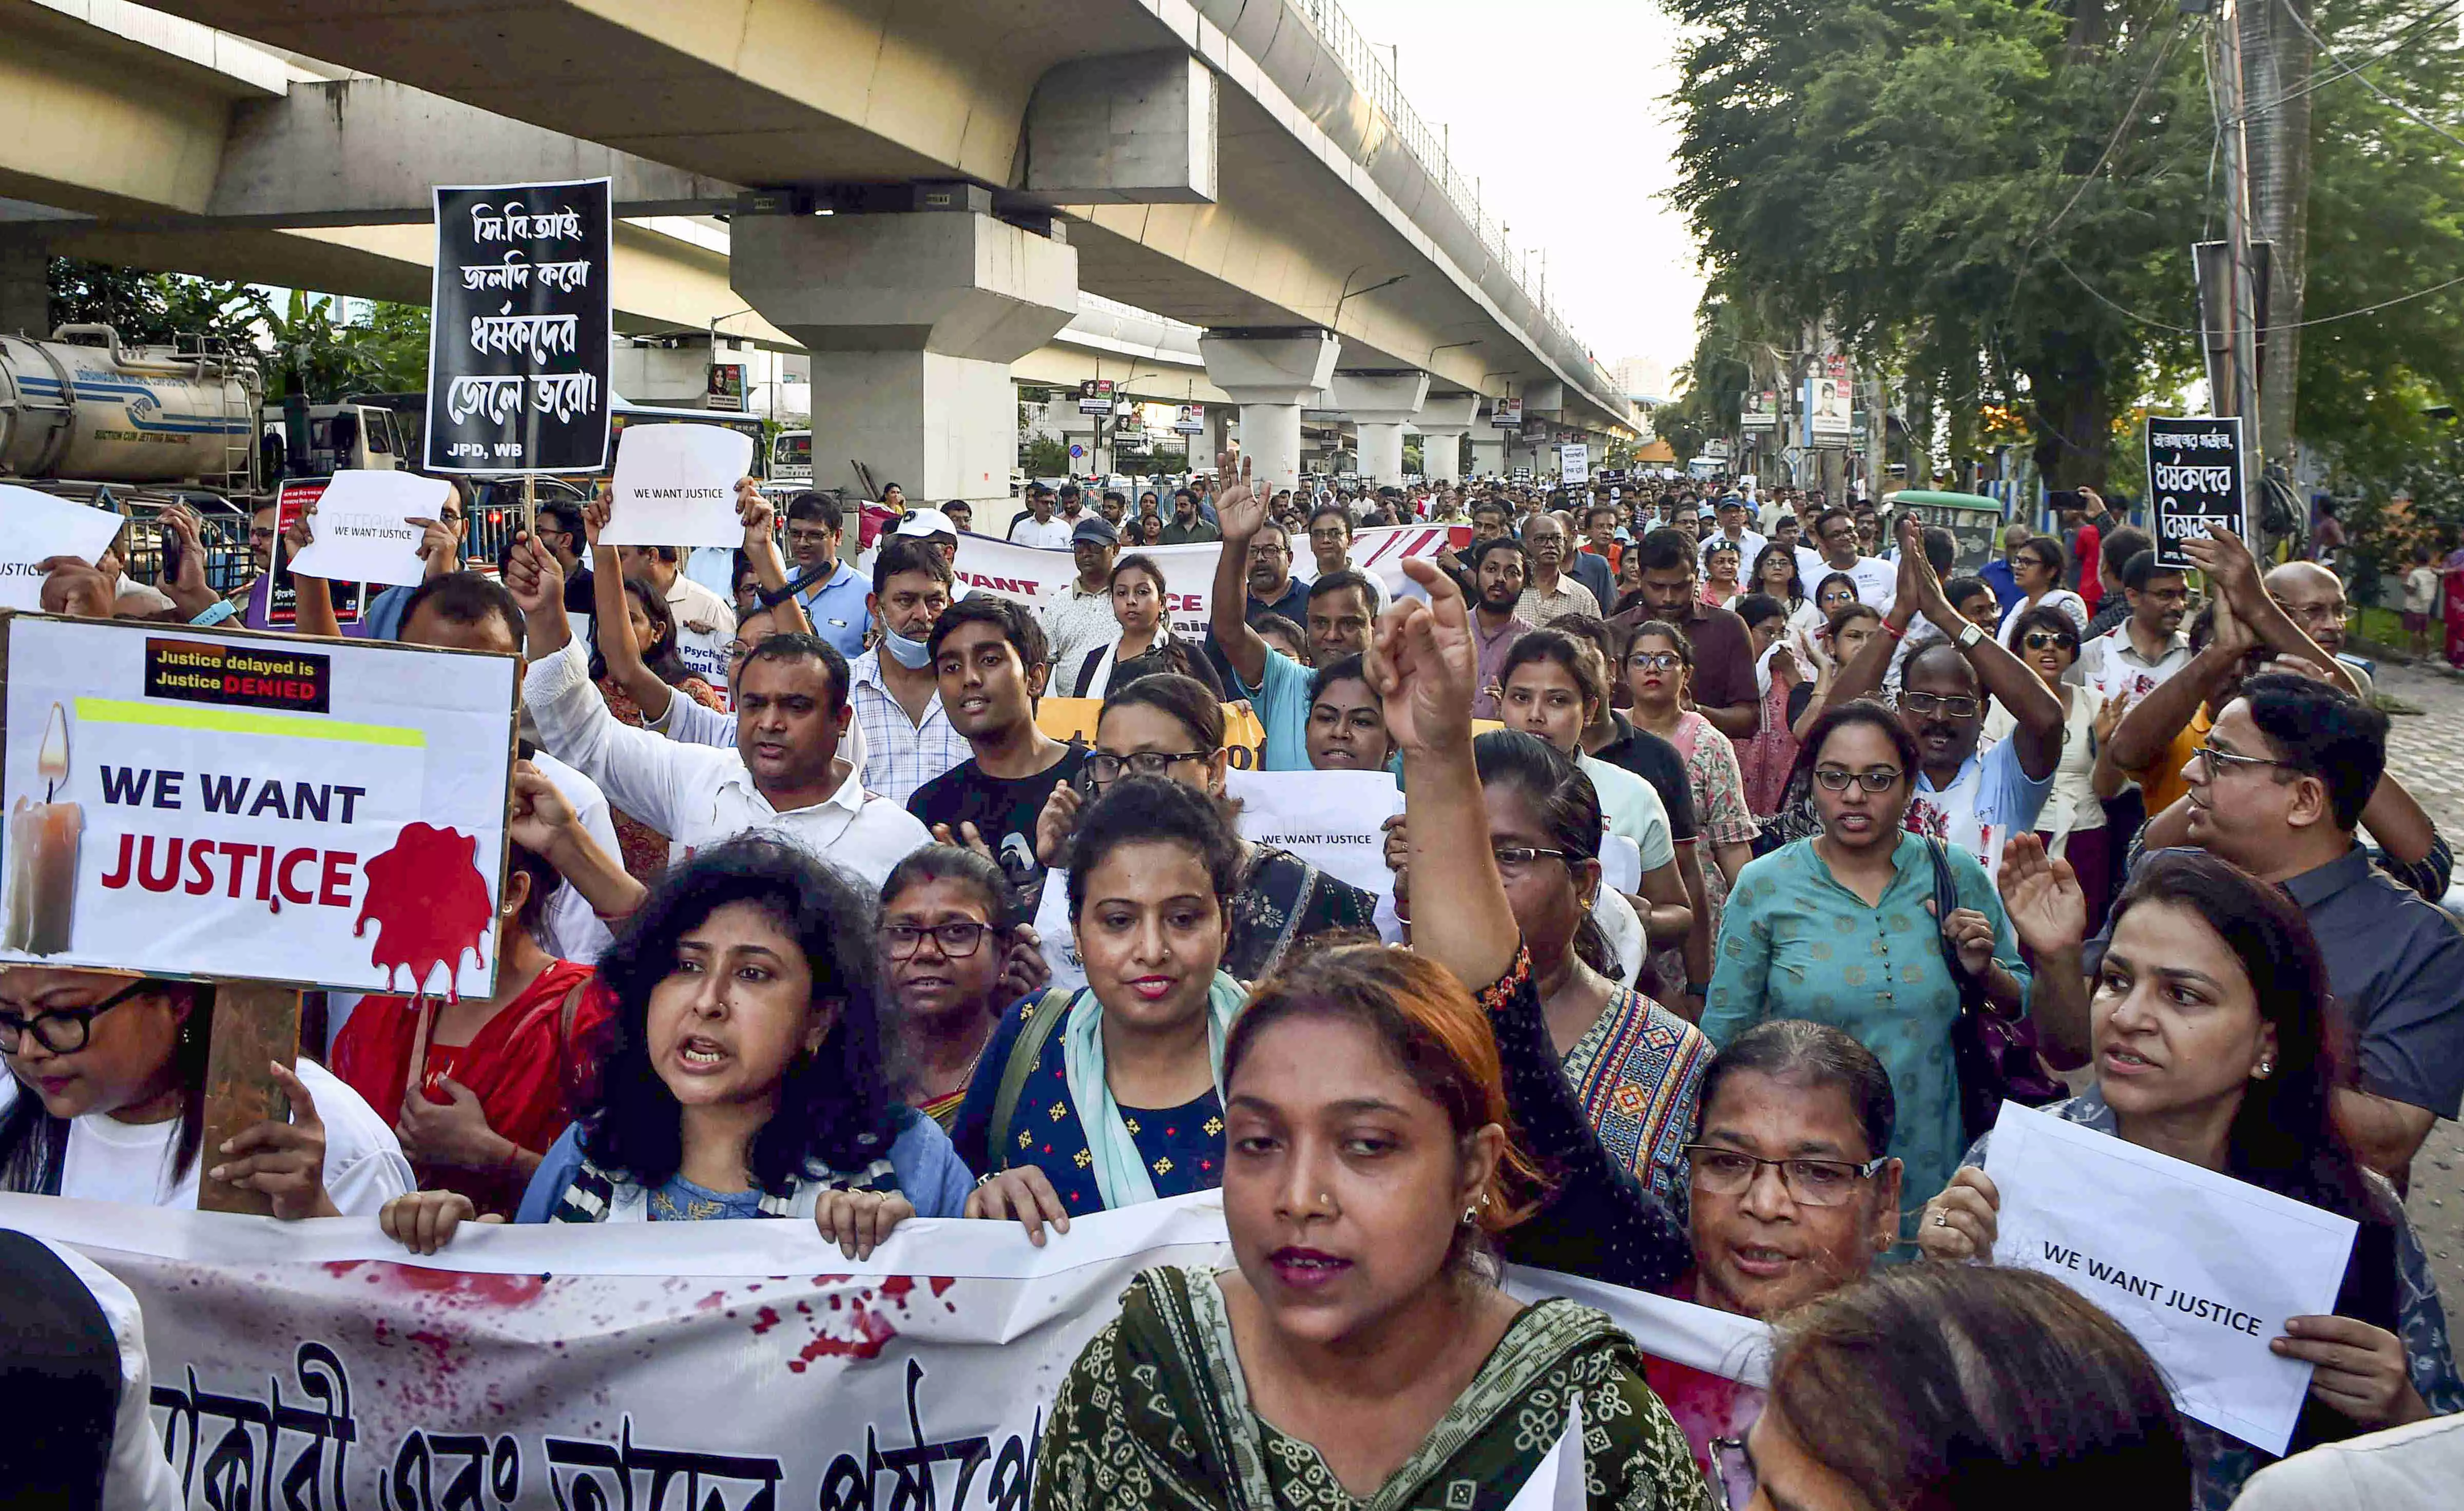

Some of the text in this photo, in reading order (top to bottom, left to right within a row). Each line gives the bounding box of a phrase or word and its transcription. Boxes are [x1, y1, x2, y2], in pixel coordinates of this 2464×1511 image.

[460, 250, 591, 293] জলদি করো
[470, 301, 579, 365] ধর্ষকদের
[447, 370, 596, 425] জেলে ভরো!
[447, 442, 523, 459] JPD, WB
[2156, 452, 2231, 496] ধর্ষকদের
[634, 489, 723, 498] WE WANT JUSTICE
[335, 526, 411, 539] WE WANT JUSTICE
[0, 563, 44, 576] USTIC
[157, 650, 314, 676] Justice delayed is
[156, 671, 316, 701] Justice DENIED
[100, 765, 365, 824] WE WANT
[1262, 834, 1372, 844] WE WANT JUSTICE
[102, 834, 358, 907] JUSTICE
[2045, 1241, 2262, 1337] WE WANT JUSTICE
